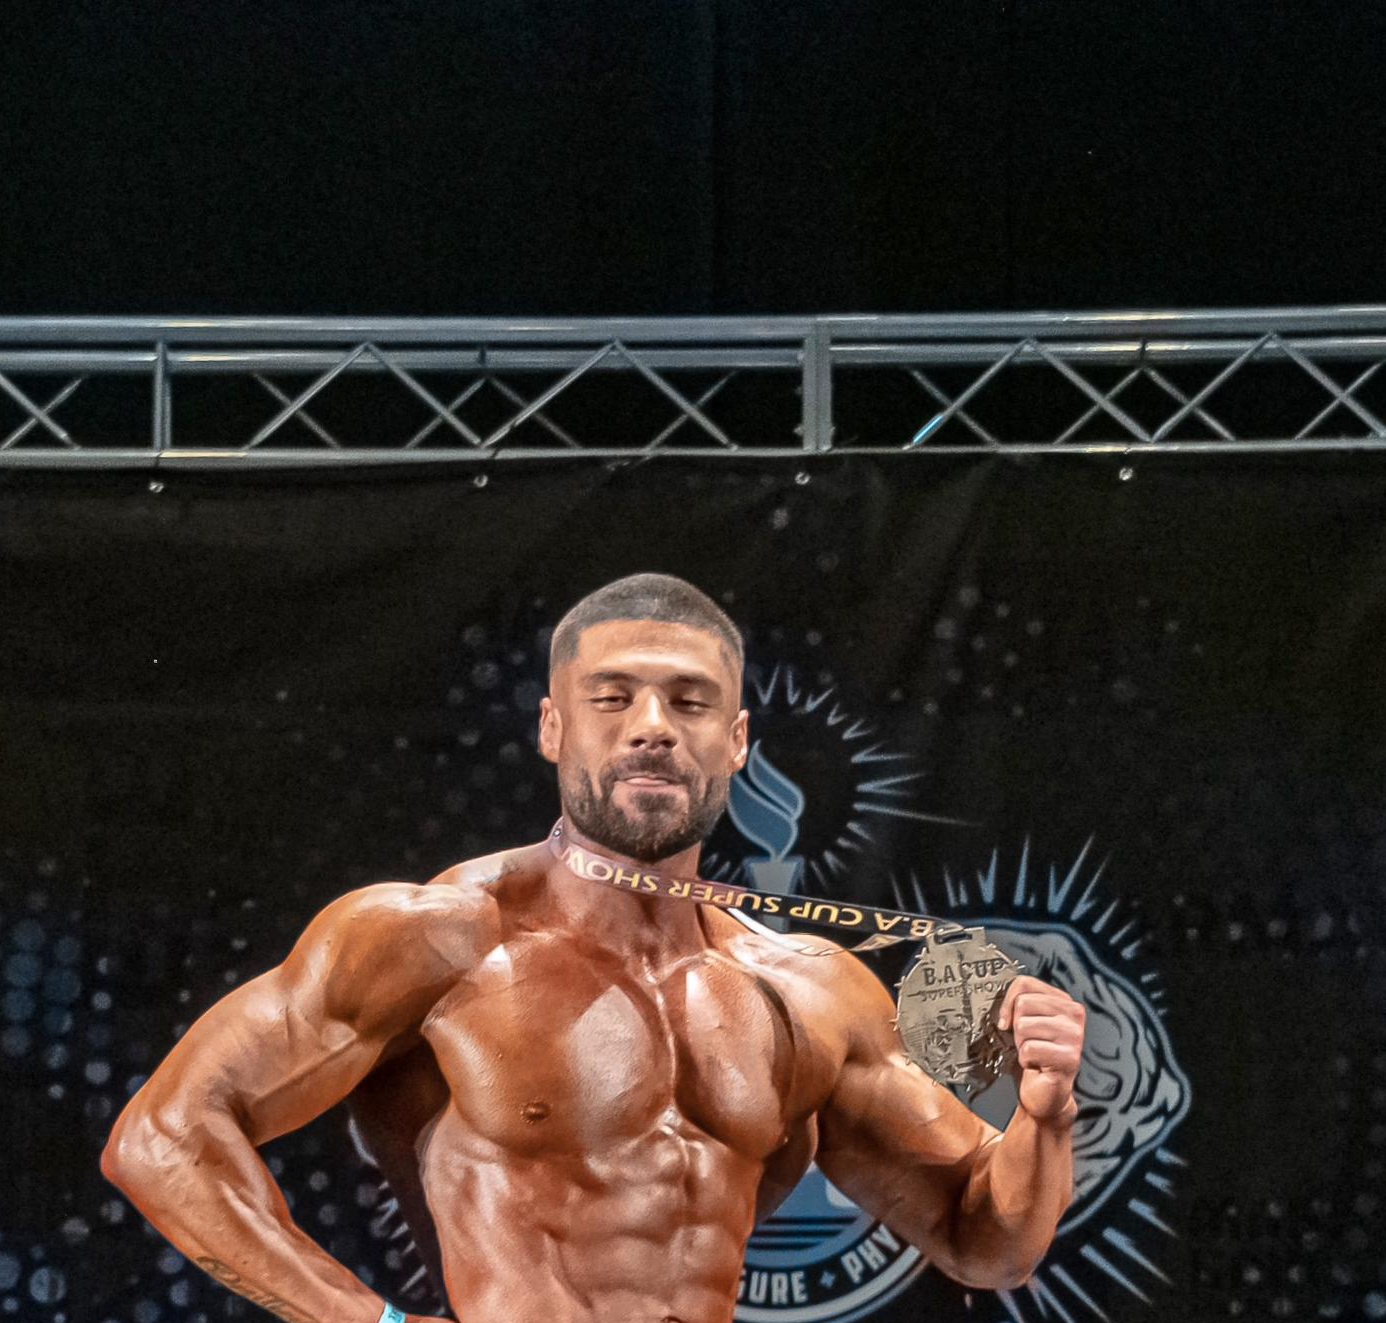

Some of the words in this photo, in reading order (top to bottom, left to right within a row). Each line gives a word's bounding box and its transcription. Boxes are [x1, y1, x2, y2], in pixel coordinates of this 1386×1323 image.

[565, 848, 662, 893] SHOW
[667, 877, 783, 914] SUPER
[789, 901, 864, 926] CUP
[840, 1222, 902, 1285] PHY
